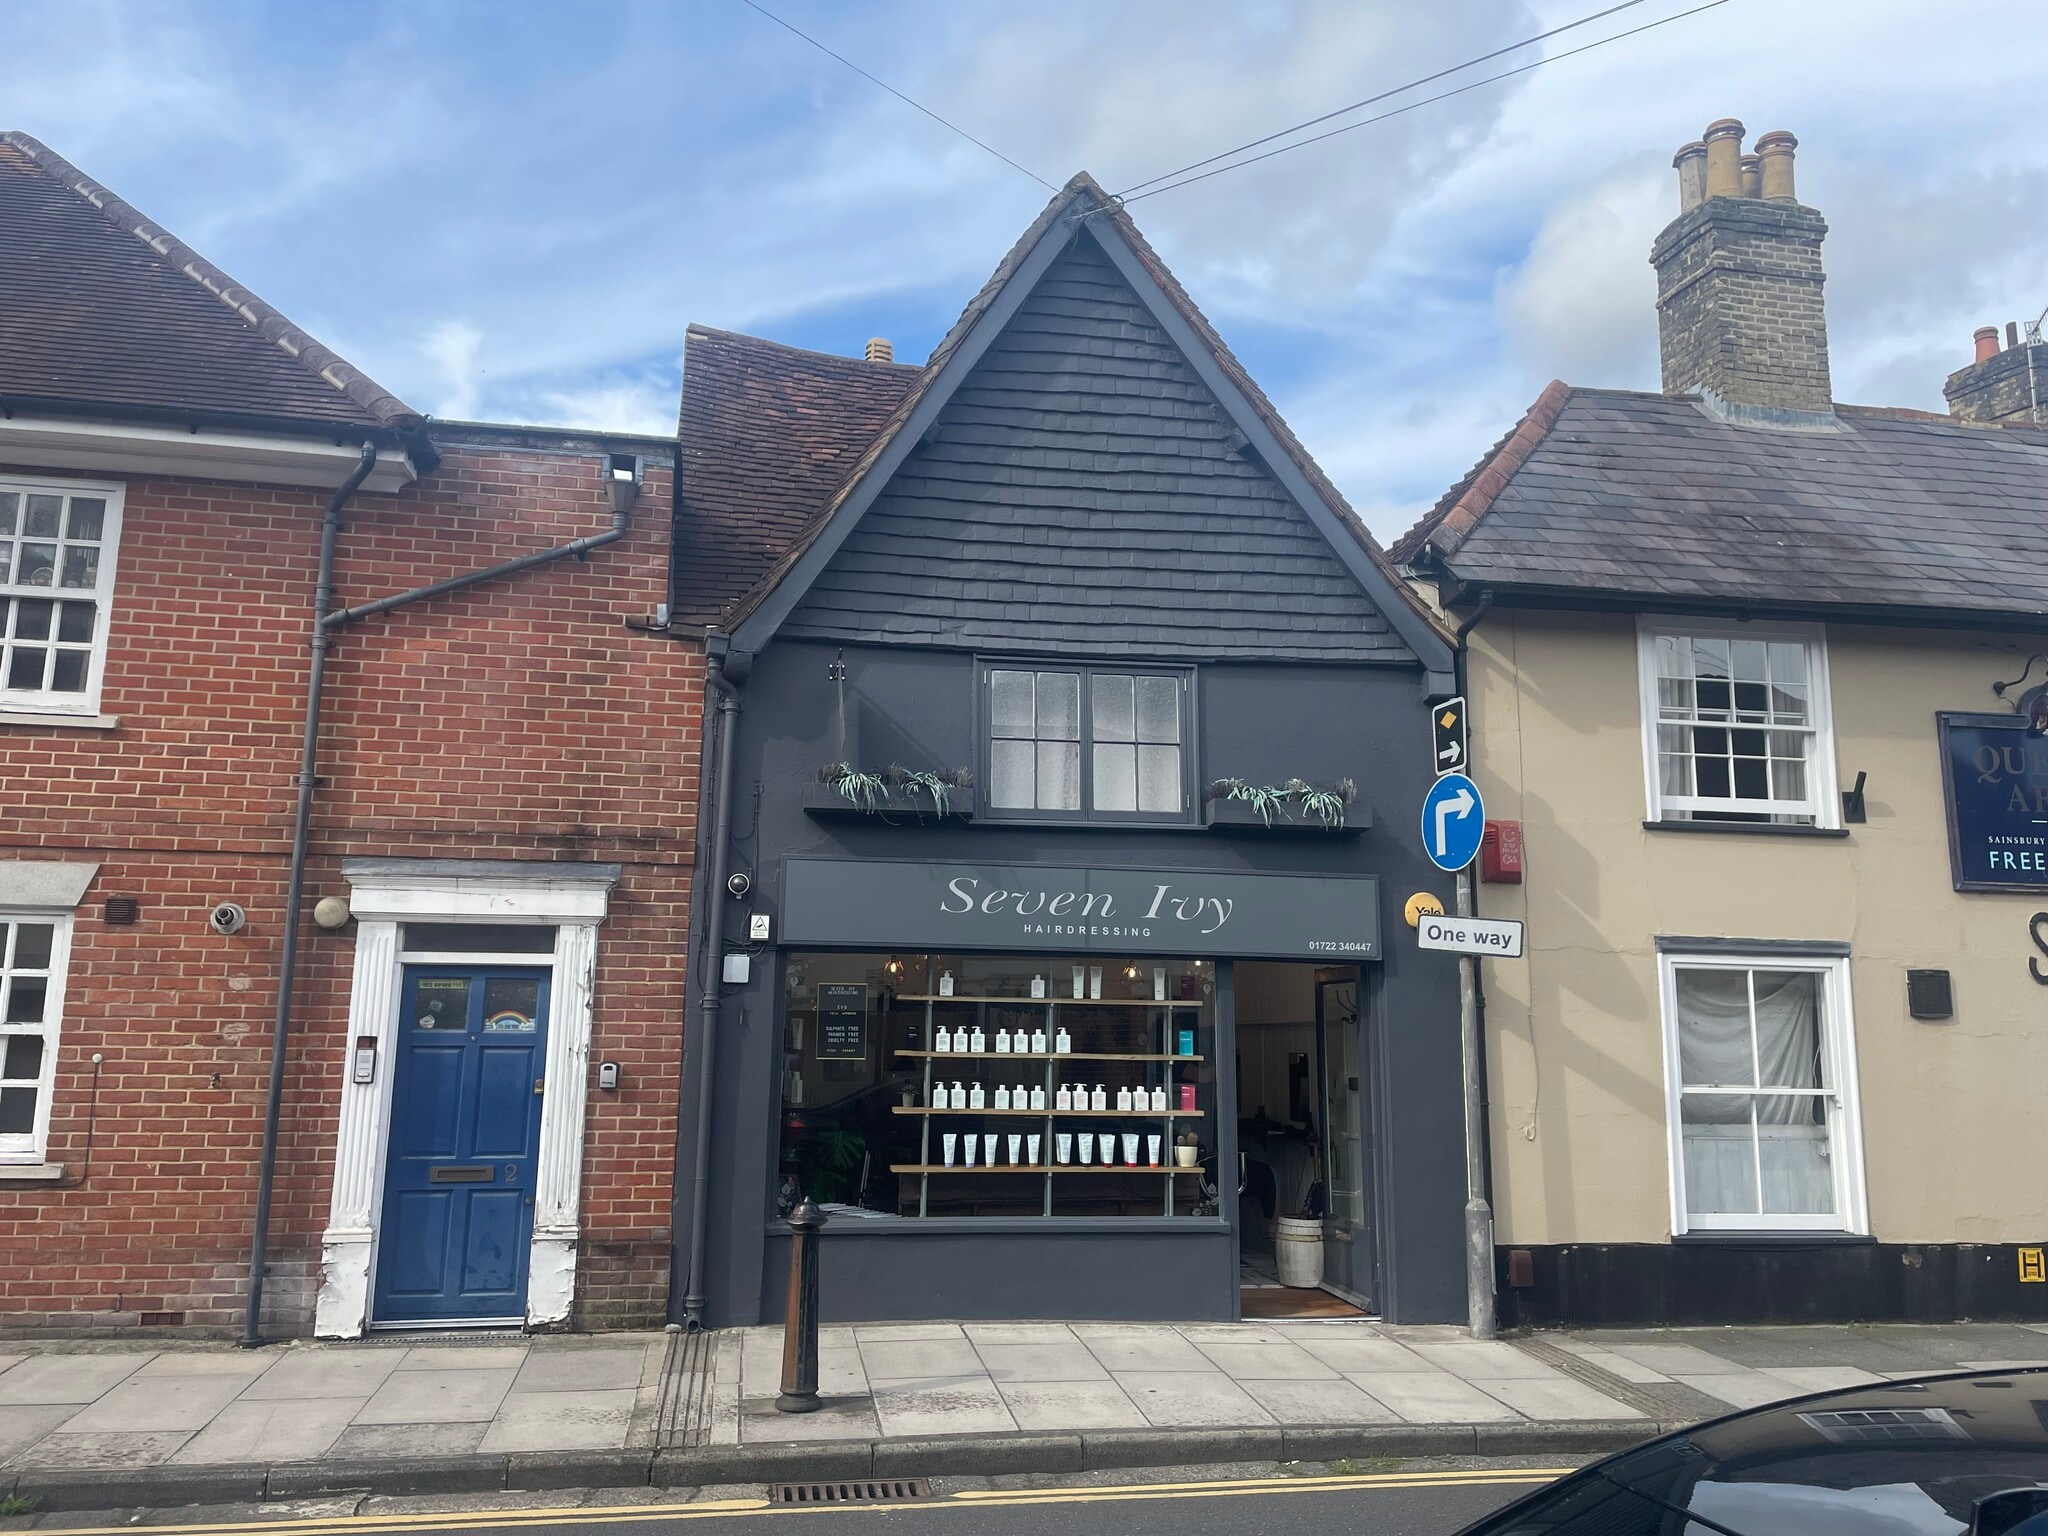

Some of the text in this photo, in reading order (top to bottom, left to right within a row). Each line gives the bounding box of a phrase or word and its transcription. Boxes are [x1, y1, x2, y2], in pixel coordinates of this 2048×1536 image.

[1988, 835, 2046, 845] SAINSBURY
[1989, 850, 2046, 870] FREE
[940, 877, 1233, 934] Seven Ivy
[1023, 924, 1151, 937] HAIRDRESSING
[1427, 925, 1513, 949] One way
[1309, 941, 1372, 952] 01722 340447
[505, 1163, 517, 1183] 2
